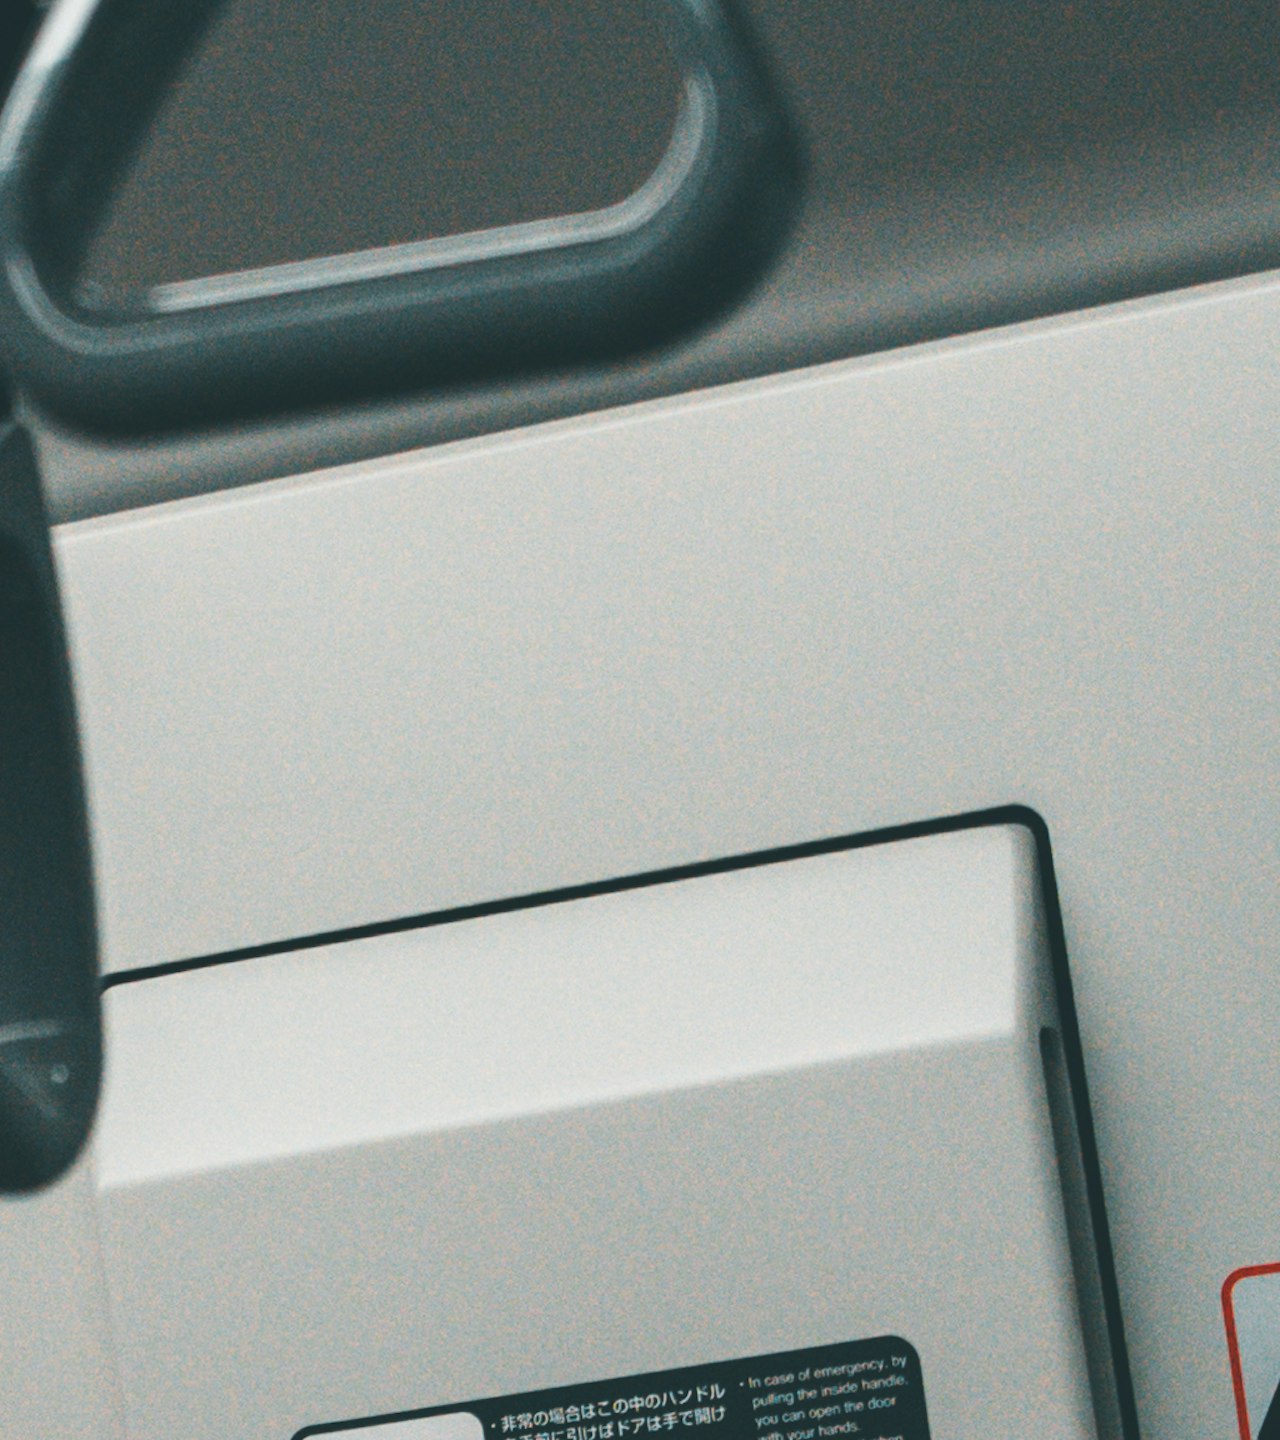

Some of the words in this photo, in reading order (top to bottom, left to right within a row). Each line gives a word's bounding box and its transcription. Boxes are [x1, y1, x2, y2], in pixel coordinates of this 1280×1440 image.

[748, 1376, 762, 1388] In
[764, 1372, 794, 1387] case
[798, 1368, 811, 1382] of
[891, 1355, 908, 1369] by
[500, 1383, 726, 1433] 非常の場合はこの中のハンドル
[752, 1390, 794, 1410] pulling
[797, 1386, 817, 1401] the
[821, 1381, 858, 1398] inside
[755, 1414, 778, 1430] you
[782, 1409, 806, 1424] can
[809, 1405, 841, 1421] open
[844, 1400, 864, 1414] the
[868, 1396, 897, 1410] door
[818, 1421, 861, 1437] hands.
